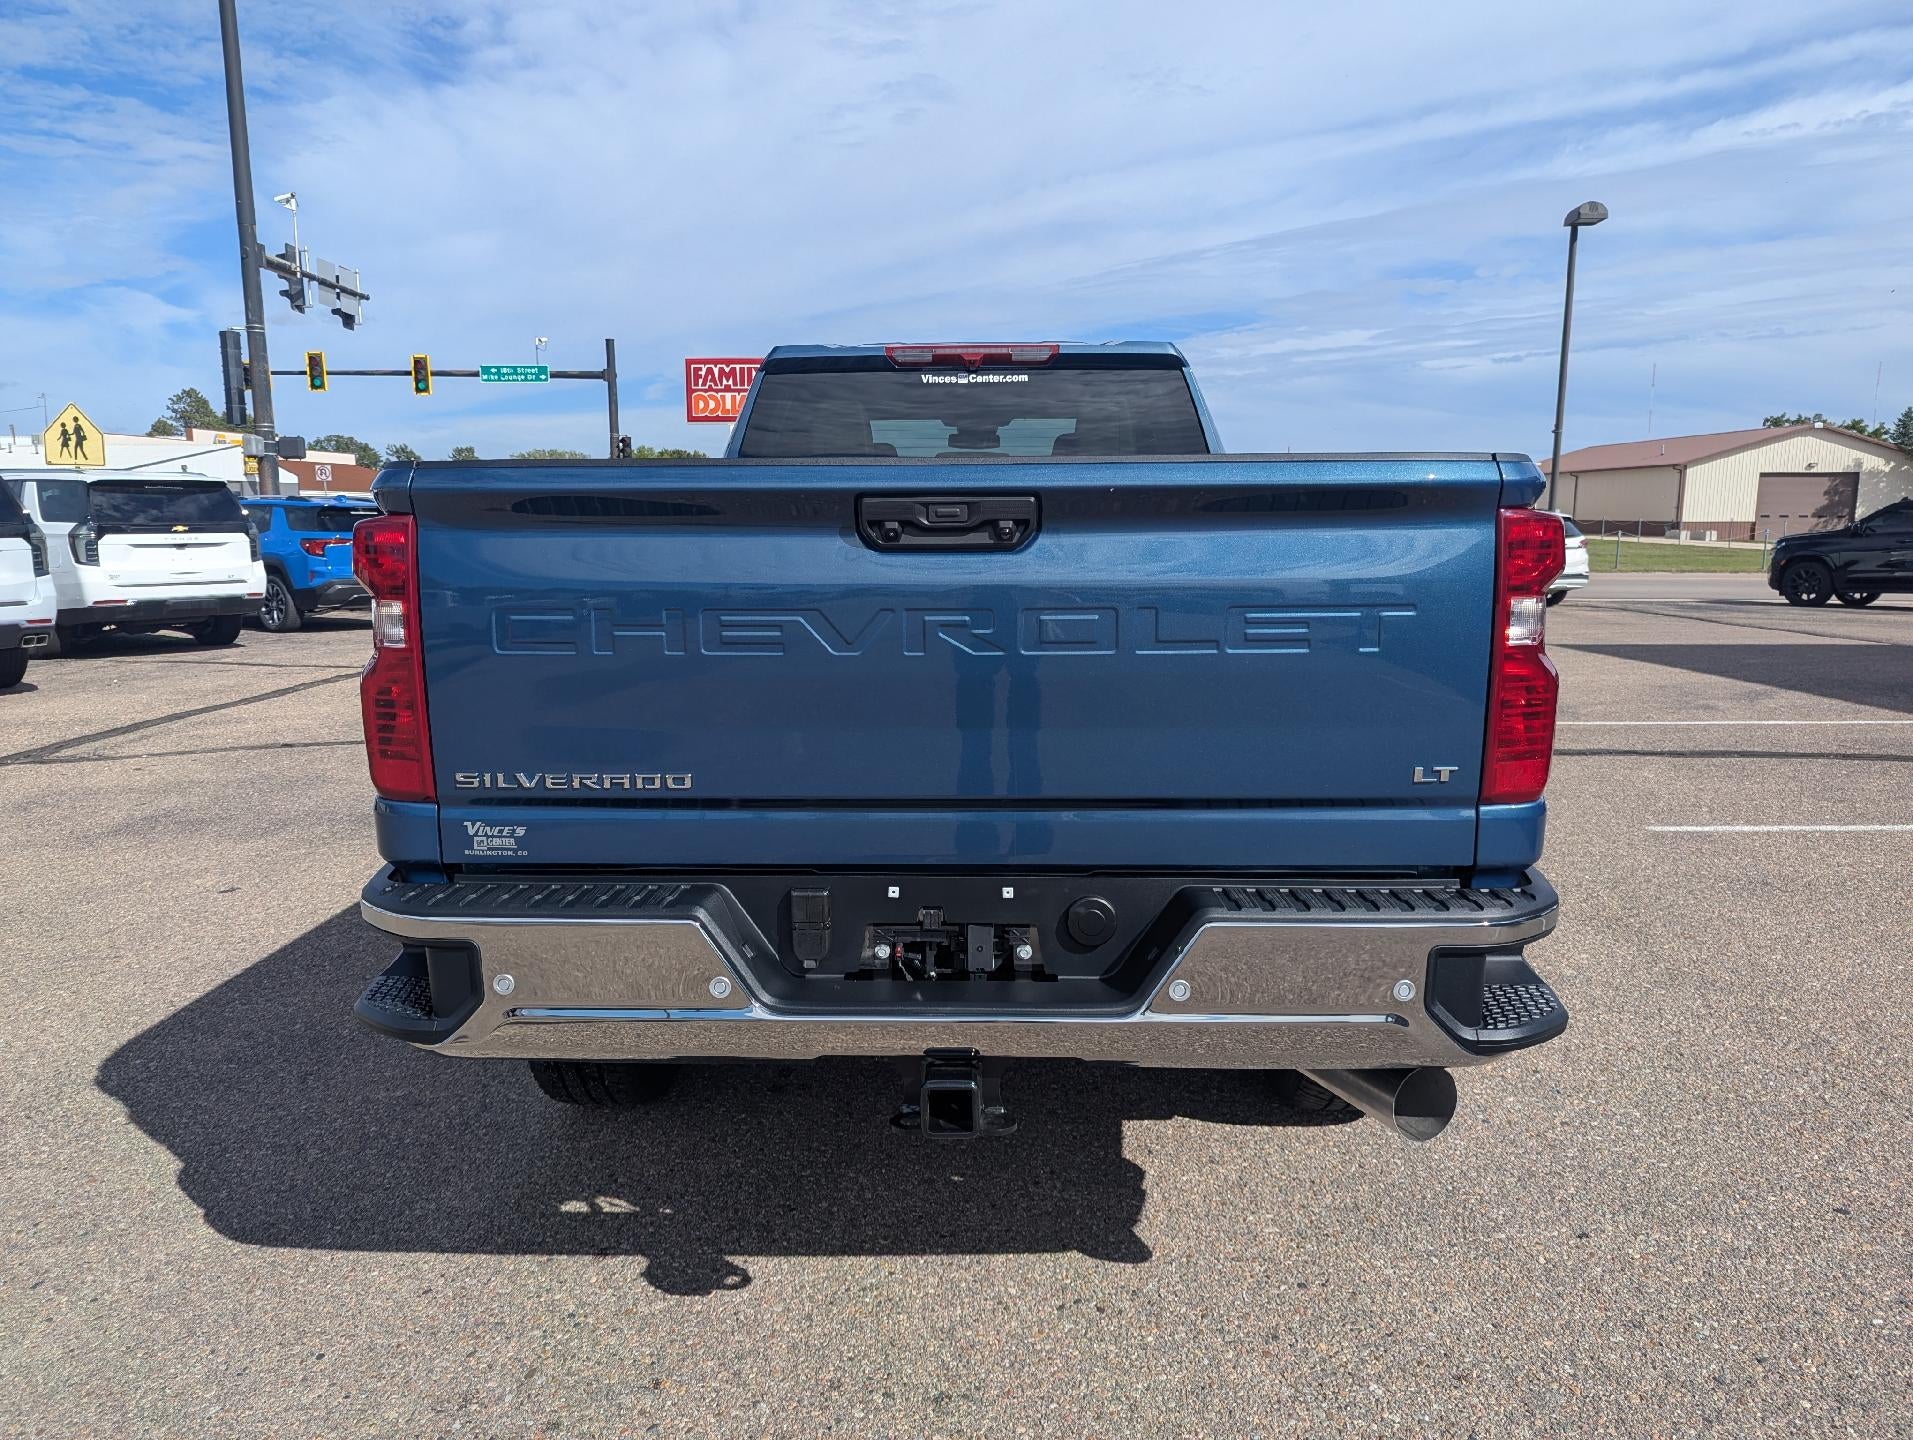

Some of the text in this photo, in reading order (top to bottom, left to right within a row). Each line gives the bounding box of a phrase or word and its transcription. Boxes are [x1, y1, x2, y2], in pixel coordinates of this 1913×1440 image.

[691, 364, 760, 389] FAMIL
[692, 392, 748, 416] DOLL
[491, 604, 1417, 655] CHEVROLET
[454, 772, 693, 789] SILVERADO
[1412, 766, 1459, 783] LT
[488, 837, 516, 846] CENTER
[464, 849, 516, 857] BURLINGTON,
